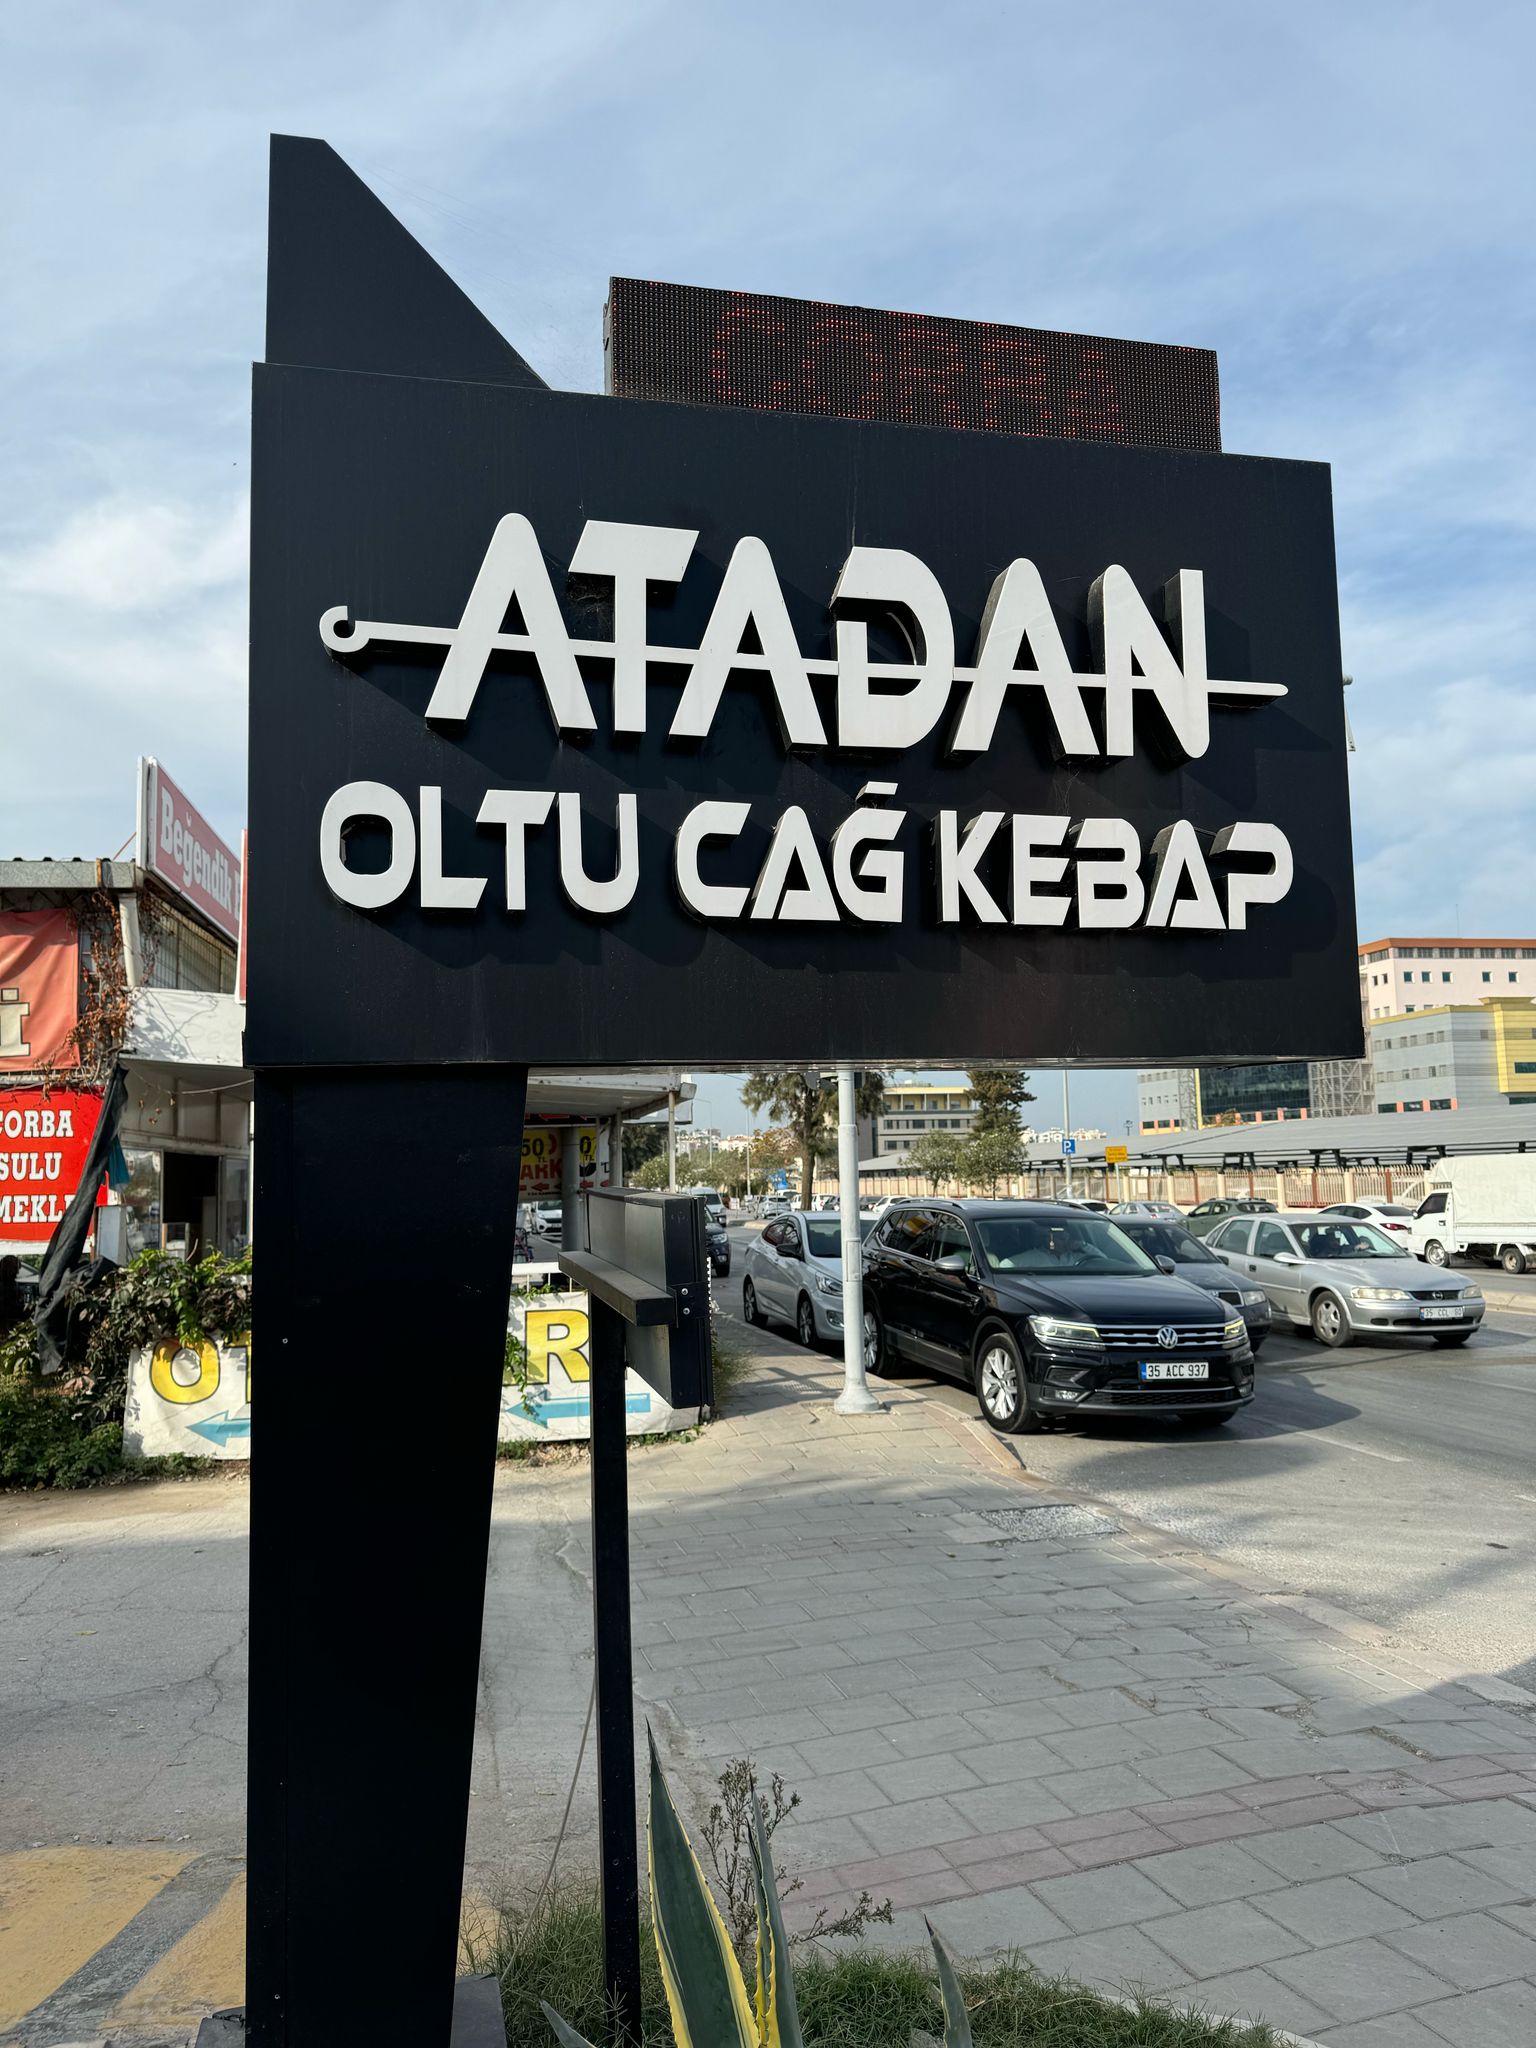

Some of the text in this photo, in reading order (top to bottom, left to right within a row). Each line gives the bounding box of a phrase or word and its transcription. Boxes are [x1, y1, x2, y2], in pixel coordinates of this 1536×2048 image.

[425, 512, 1210, 759] ATADAN
[160, 786, 232, 914] Beğendik
[319, 780, 1295, 936] OLTU CAĞ KEBAP
[0, 1109, 74, 1139] ORBA
[1148, 1365, 1160, 1377] 35
[1166, 1364, 1184, 1377] ACC
[1188, 1364, 1206, 1377] 937
